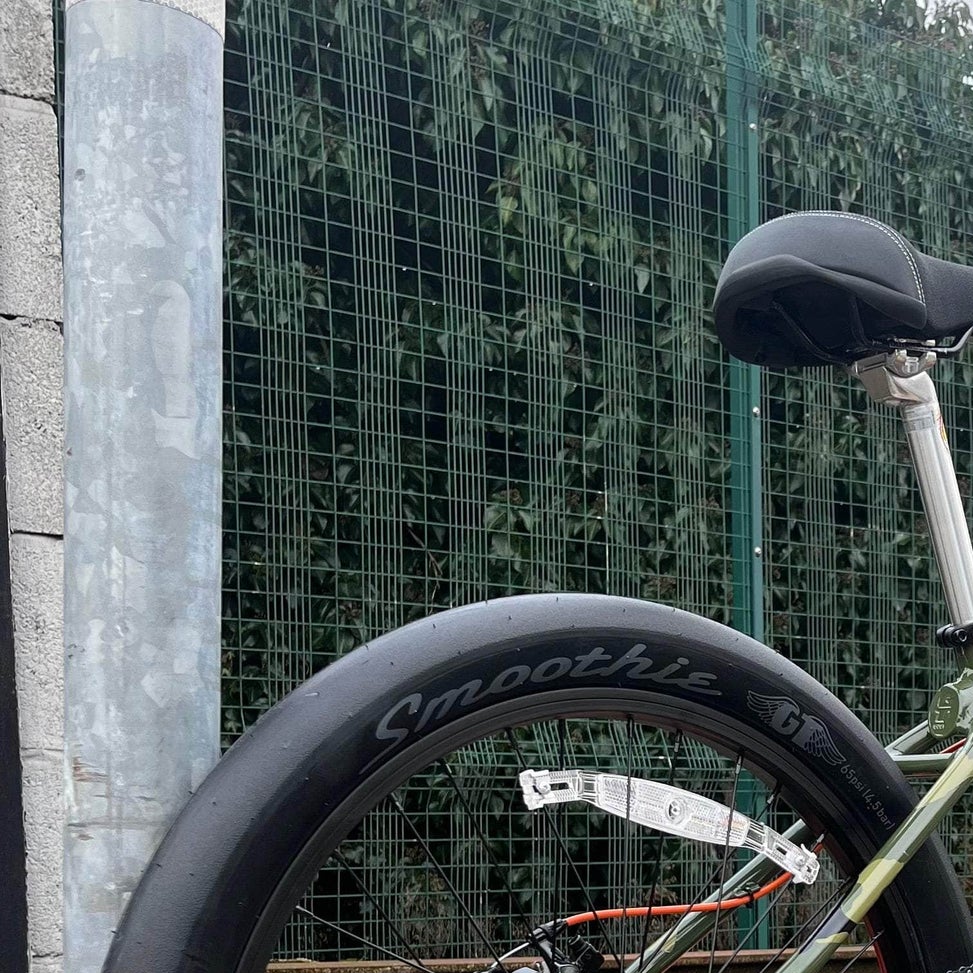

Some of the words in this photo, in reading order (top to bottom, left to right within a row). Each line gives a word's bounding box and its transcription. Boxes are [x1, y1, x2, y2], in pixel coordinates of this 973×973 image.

[364, 643, 724, 764] Smoothie
[840, 764, 865, 791] 65psi
[876, 807, 896, 830] bar)
